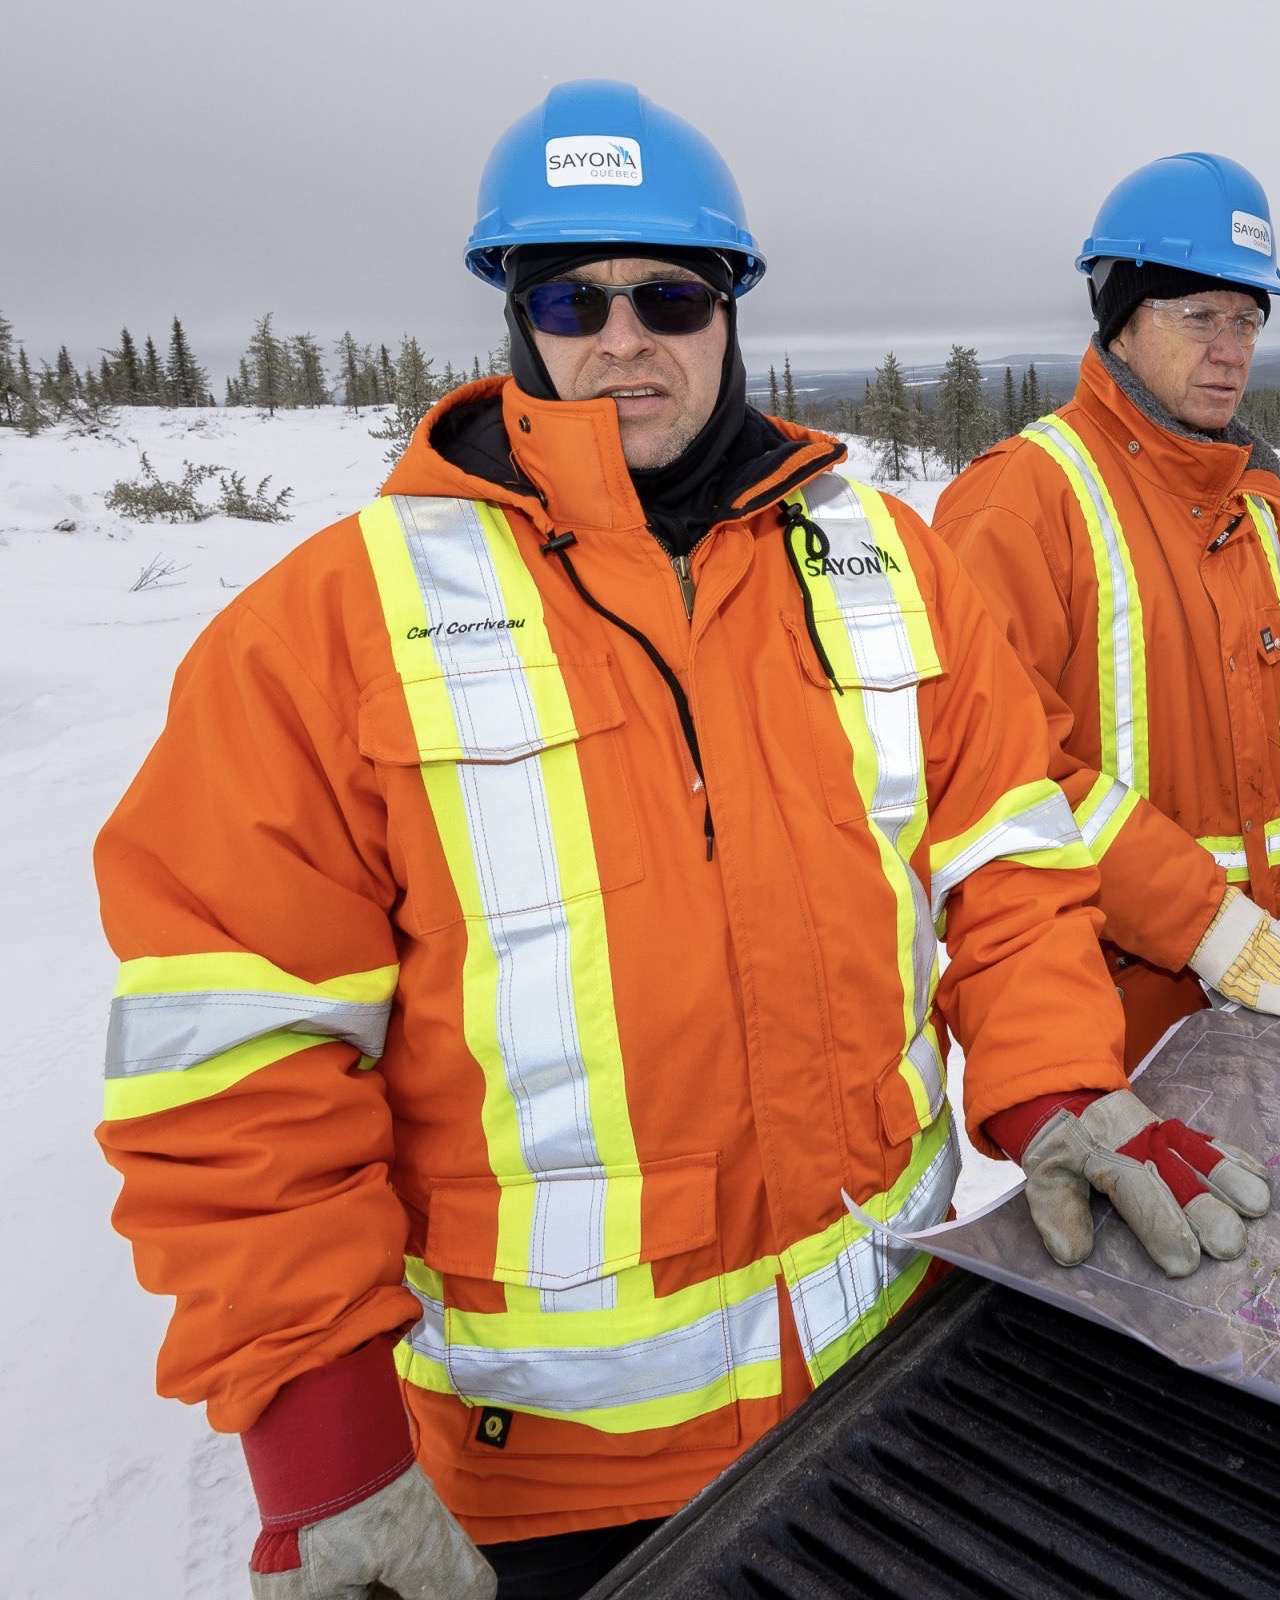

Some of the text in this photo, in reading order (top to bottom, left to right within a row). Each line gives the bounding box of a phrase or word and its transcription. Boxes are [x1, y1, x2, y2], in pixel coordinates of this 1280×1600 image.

[549, 150, 637, 170] SAYONA
[1233, 222, 1271, 245] SAYONA
[804, 555, 902, 577] SAYONA
[406, 617, 526, 640] Carl Corriveau
